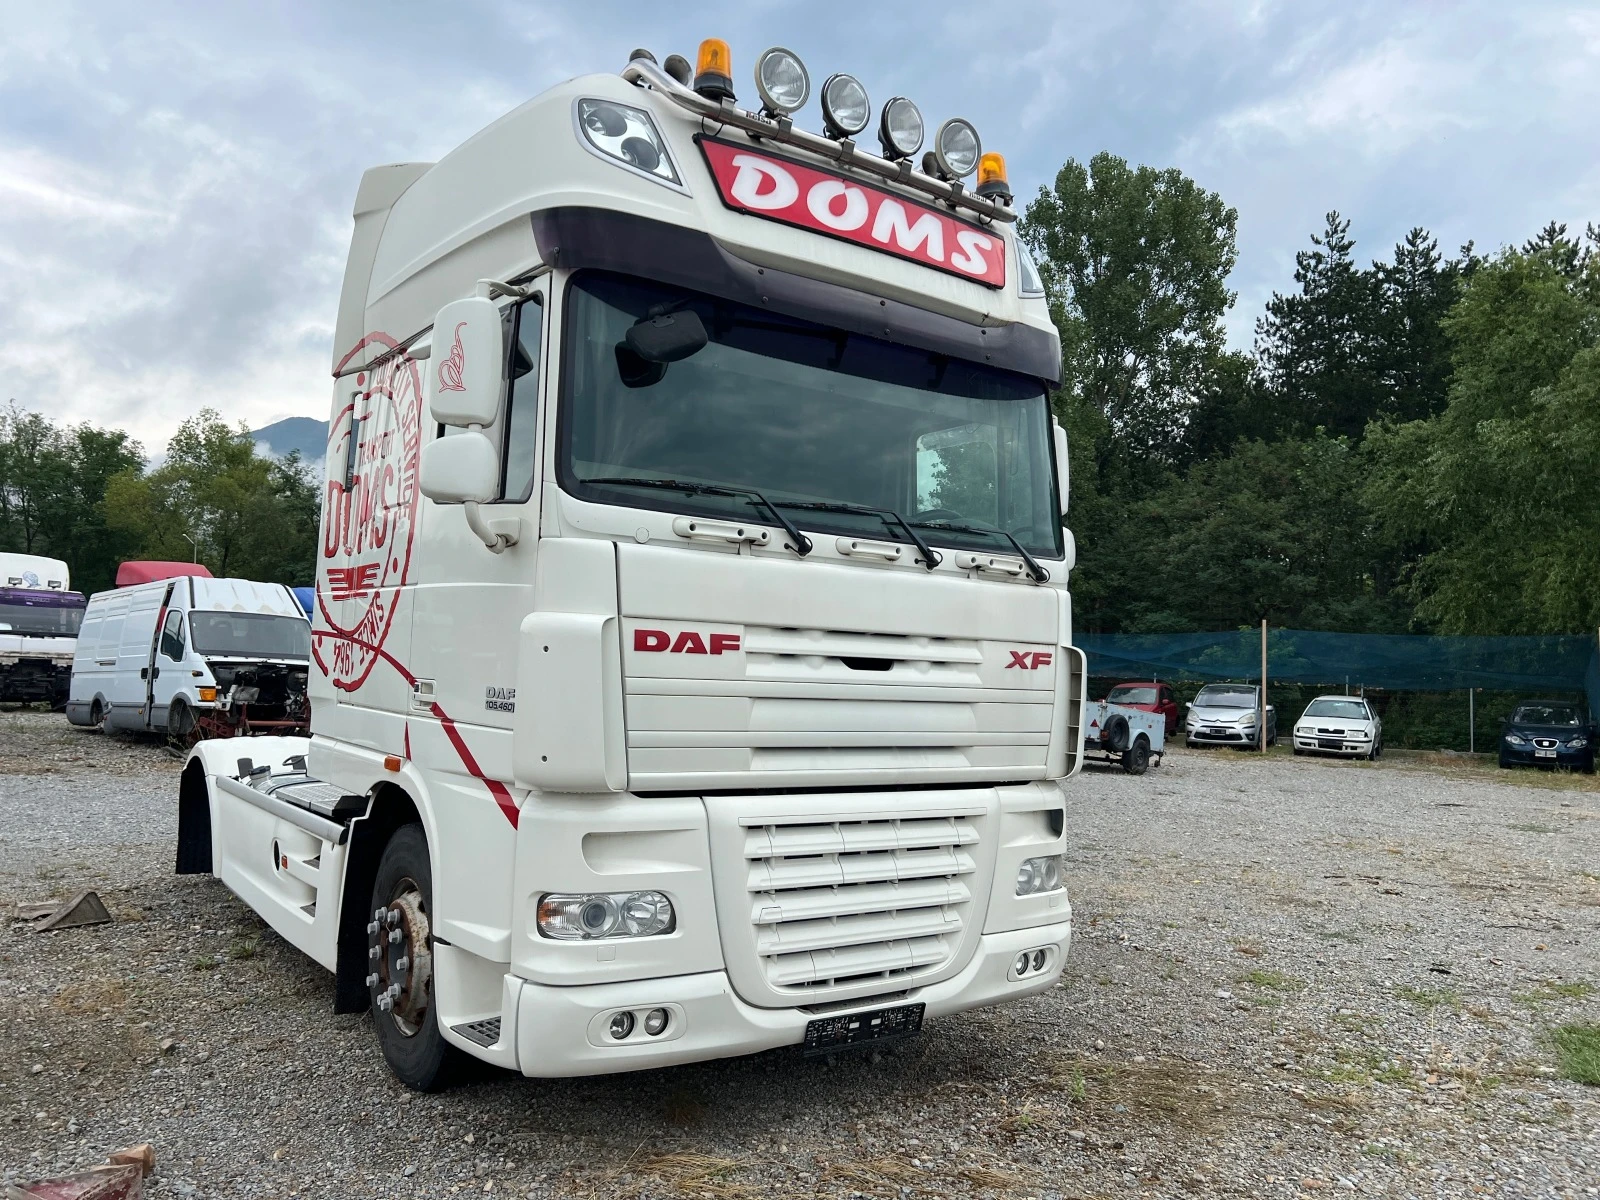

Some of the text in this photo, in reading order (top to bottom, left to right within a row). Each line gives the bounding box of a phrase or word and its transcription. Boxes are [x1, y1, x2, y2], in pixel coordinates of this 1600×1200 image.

[731, 154, 992, 275] DOMS
[633, 629, 740, 655] DAF
[1005, 650, 1052, 670] XF
[485, 686, 516, 700] DAF
[485, 701, 513, 712] 105.460
